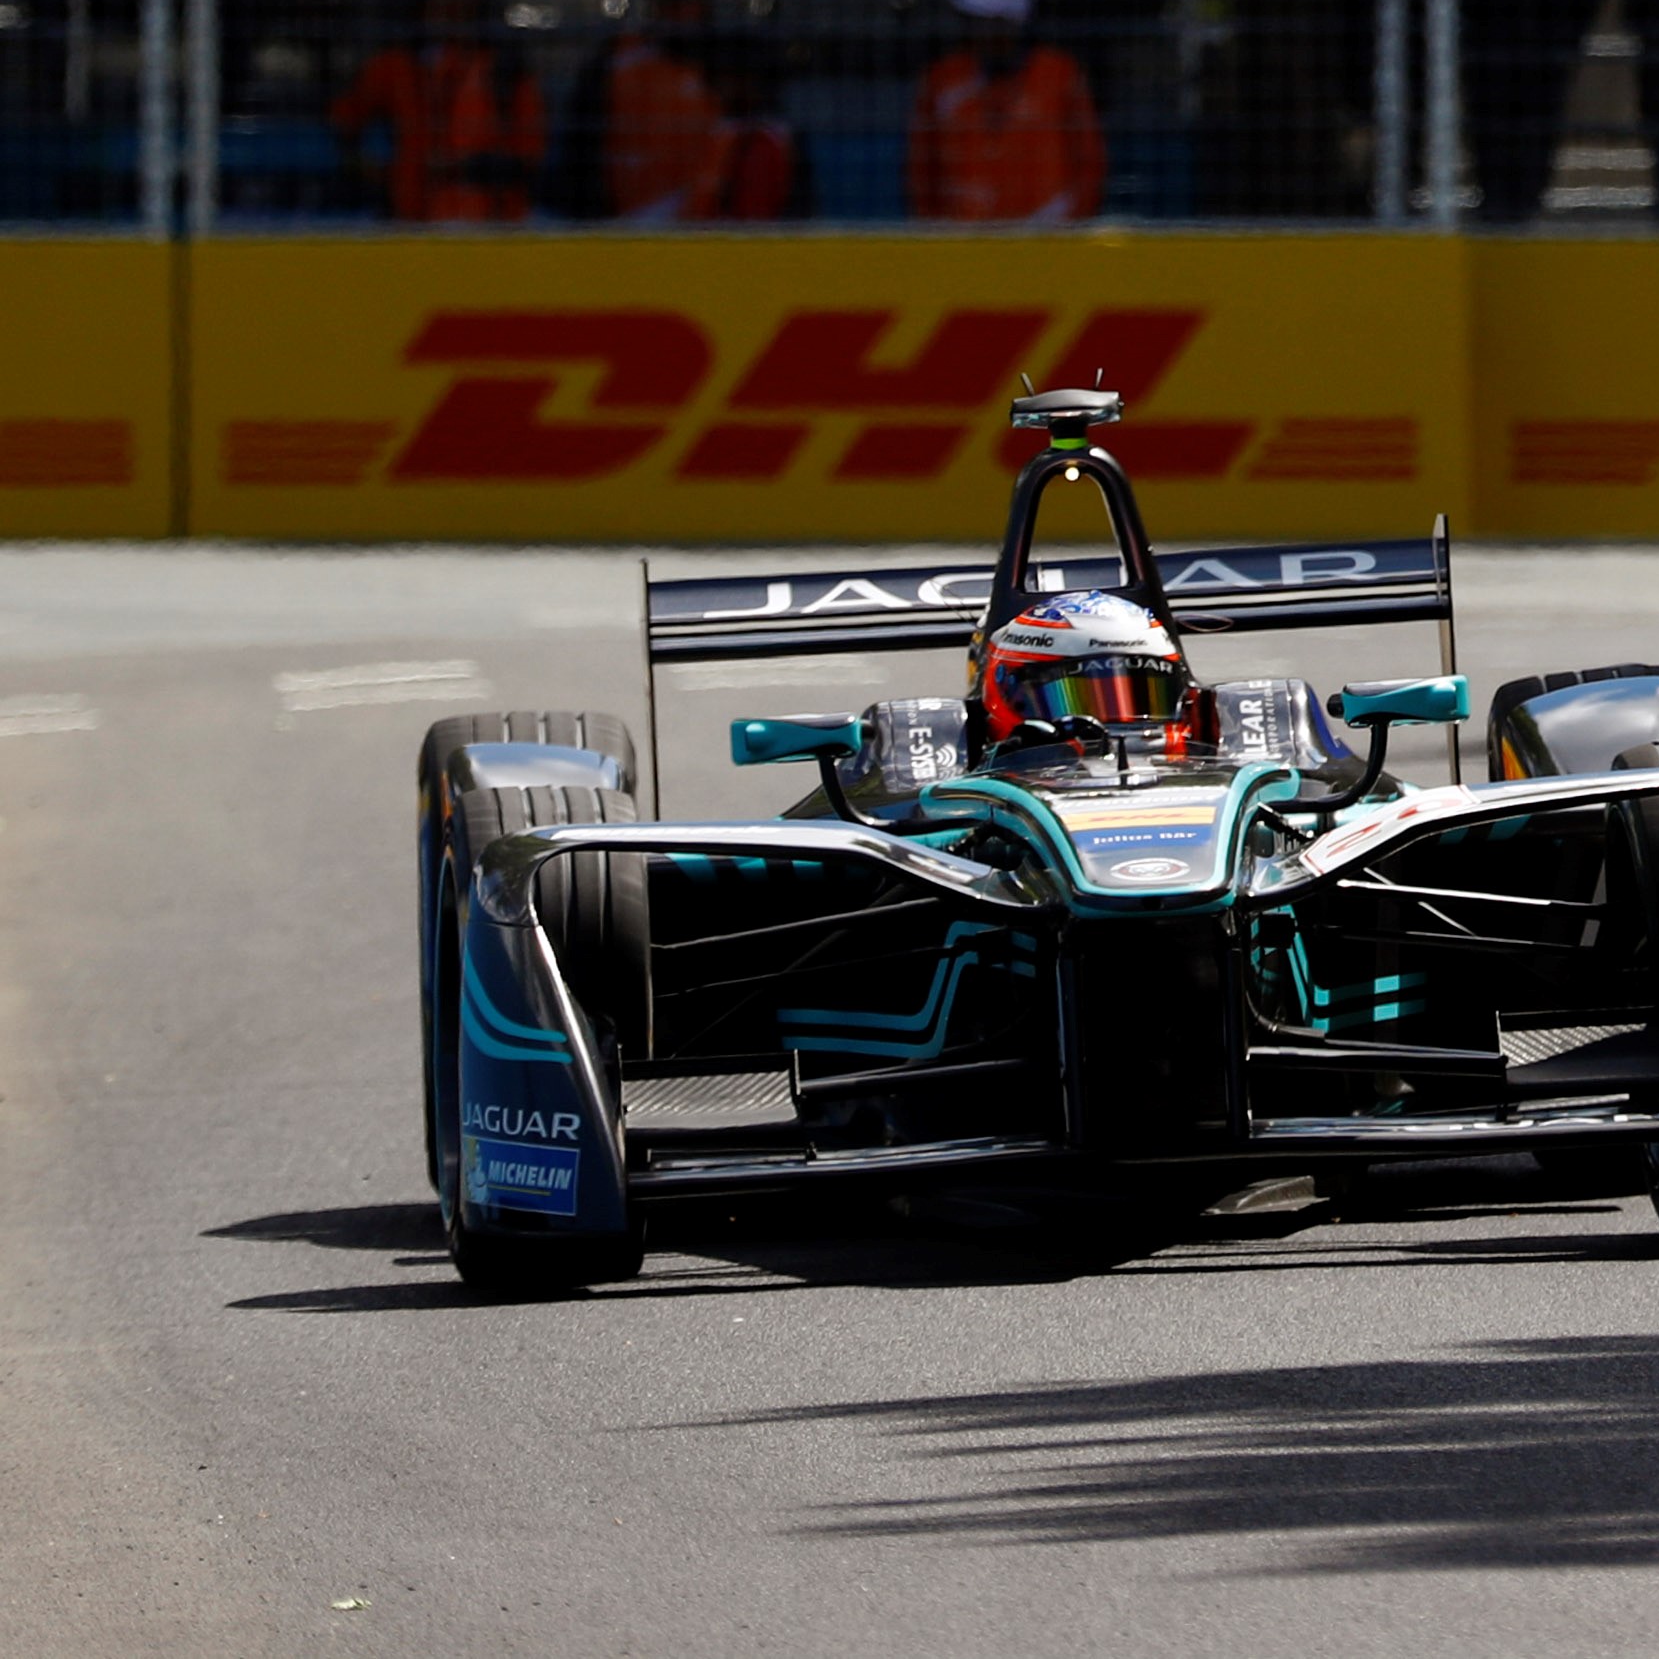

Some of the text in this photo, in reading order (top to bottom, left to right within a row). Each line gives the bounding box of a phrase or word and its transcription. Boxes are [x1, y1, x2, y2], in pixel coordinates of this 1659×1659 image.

[386, 307, 1255, 482] DHL
[1068, 656, 1174, 675] JAGUAR
[1239, 699, 1266, 753] LEAR
[462, 1101, 581, 1141] JAGUAR
[487, 1159, 573, 1191] MICHELIN
